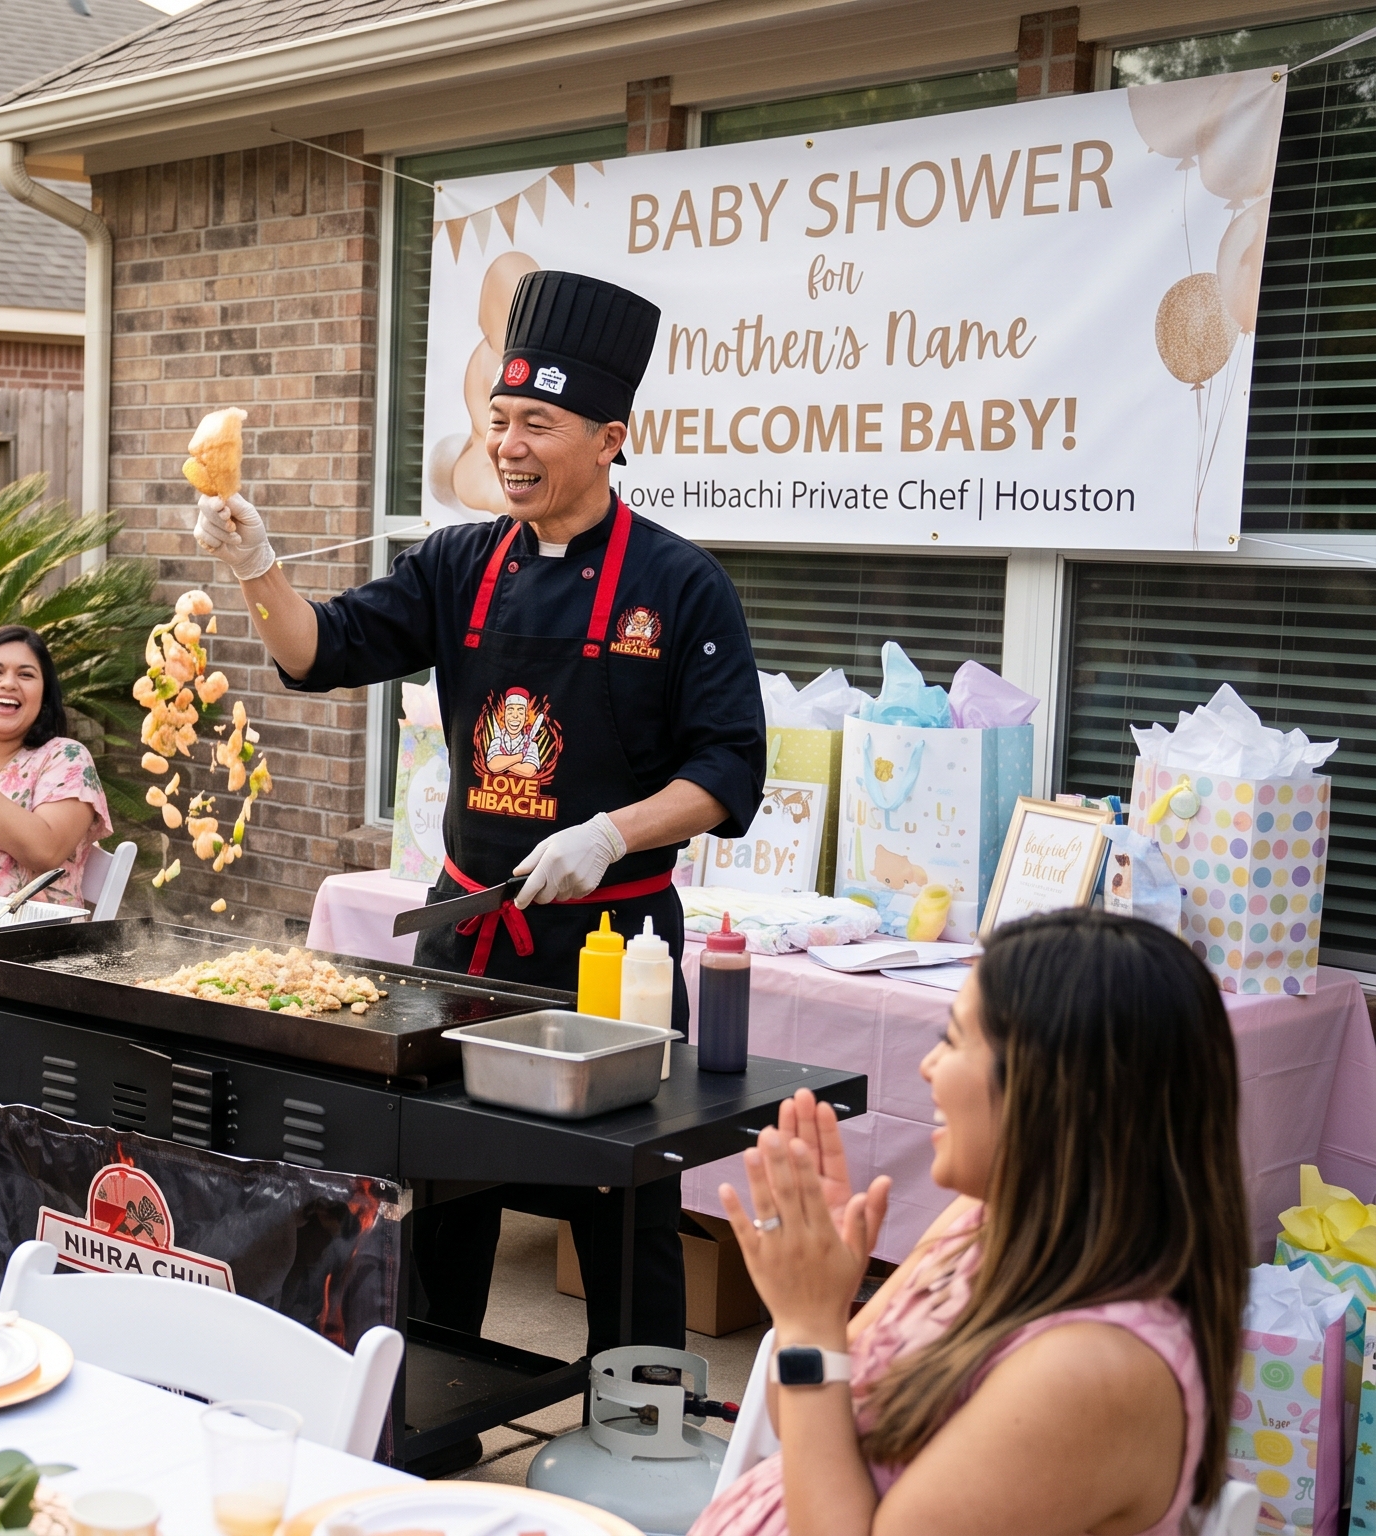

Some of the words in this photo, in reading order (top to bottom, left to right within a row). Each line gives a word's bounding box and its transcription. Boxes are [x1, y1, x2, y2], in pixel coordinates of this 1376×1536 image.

[627, 178, 789, 254] BABY
[804, 139, 1114, 238] SHOWER
[807, 254, 864, 300] for
[668, 314, 869, 377] Mother's
[886, 309, 1037, 369] Name
[628, 404, 883, 455] WELCOME
[901, 397, 1077, 452] BABY!
[618, 480, 675, 507] Love
[683, 479, 782, 508] Hibachi
[792, 480, 888, 510] Private
[898, 479, 969, 511] Chef
[995, 480, 1135, 512] Houston
[468, 789, 555, 818] HIBACHI
[482, 774, 539, 797] LOVE
[64, 1230, 143, 1274] NIHRA
